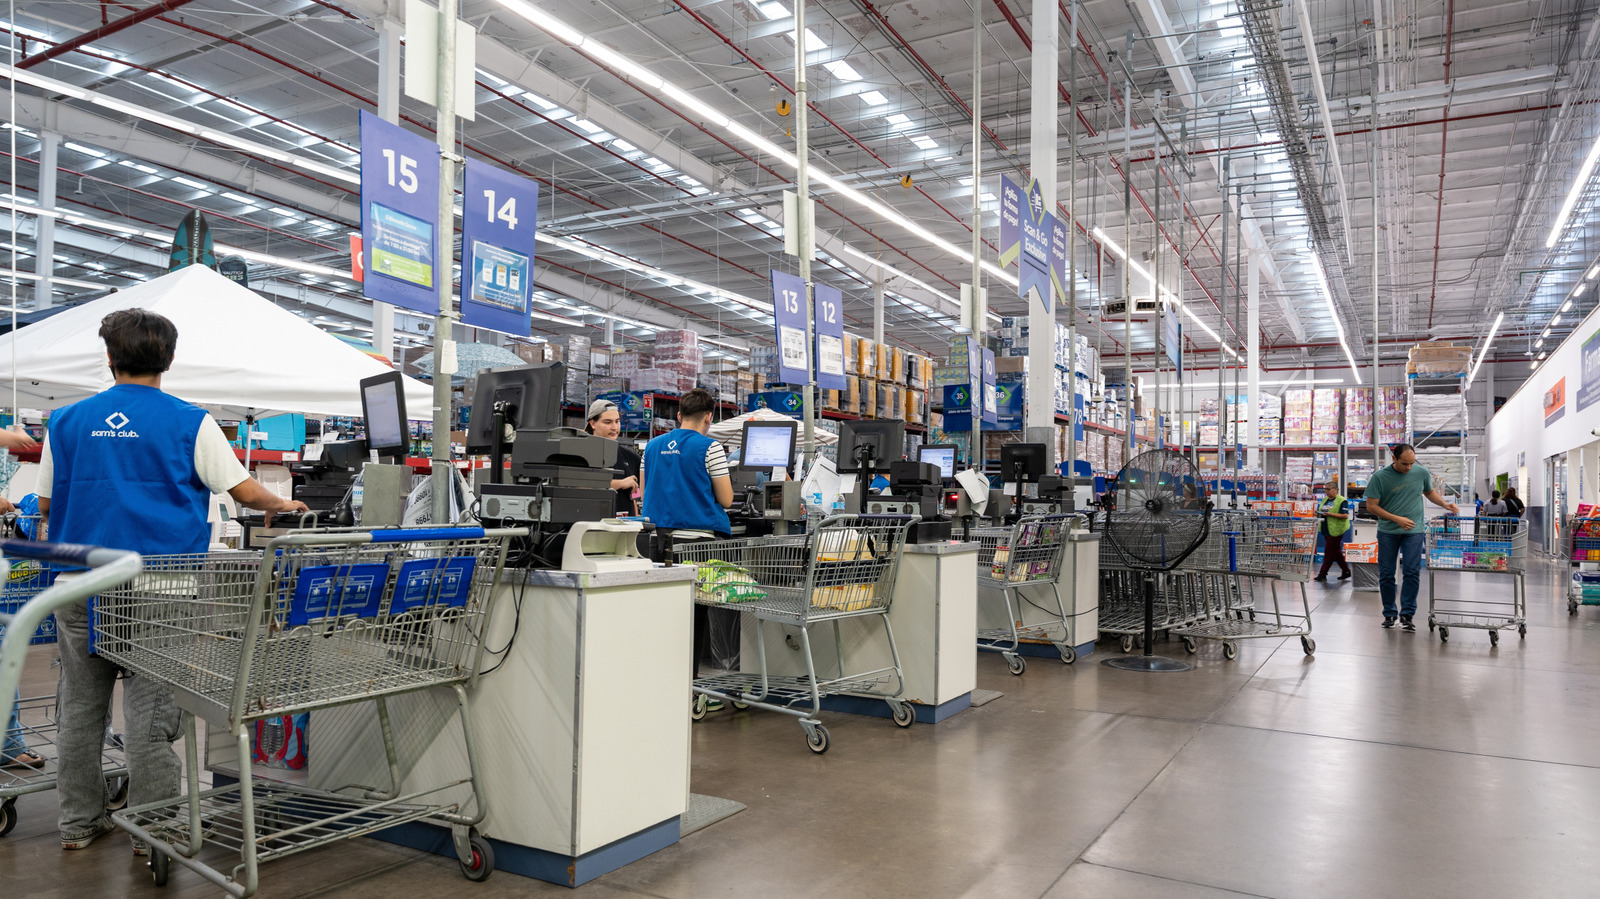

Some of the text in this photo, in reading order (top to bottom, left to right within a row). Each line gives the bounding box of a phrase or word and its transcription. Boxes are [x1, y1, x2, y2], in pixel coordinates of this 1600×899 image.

[382, 149, 418, 194] 15
[484, 190, 518, 230] 14
[1024, 220, 1048, 247] Scan & Go
[782, 290, 798, 314] 13
[822, 301, 836, 324] 12
[985, 359, 992, 376] 10
[1074, 408, 1082, 425] 78
